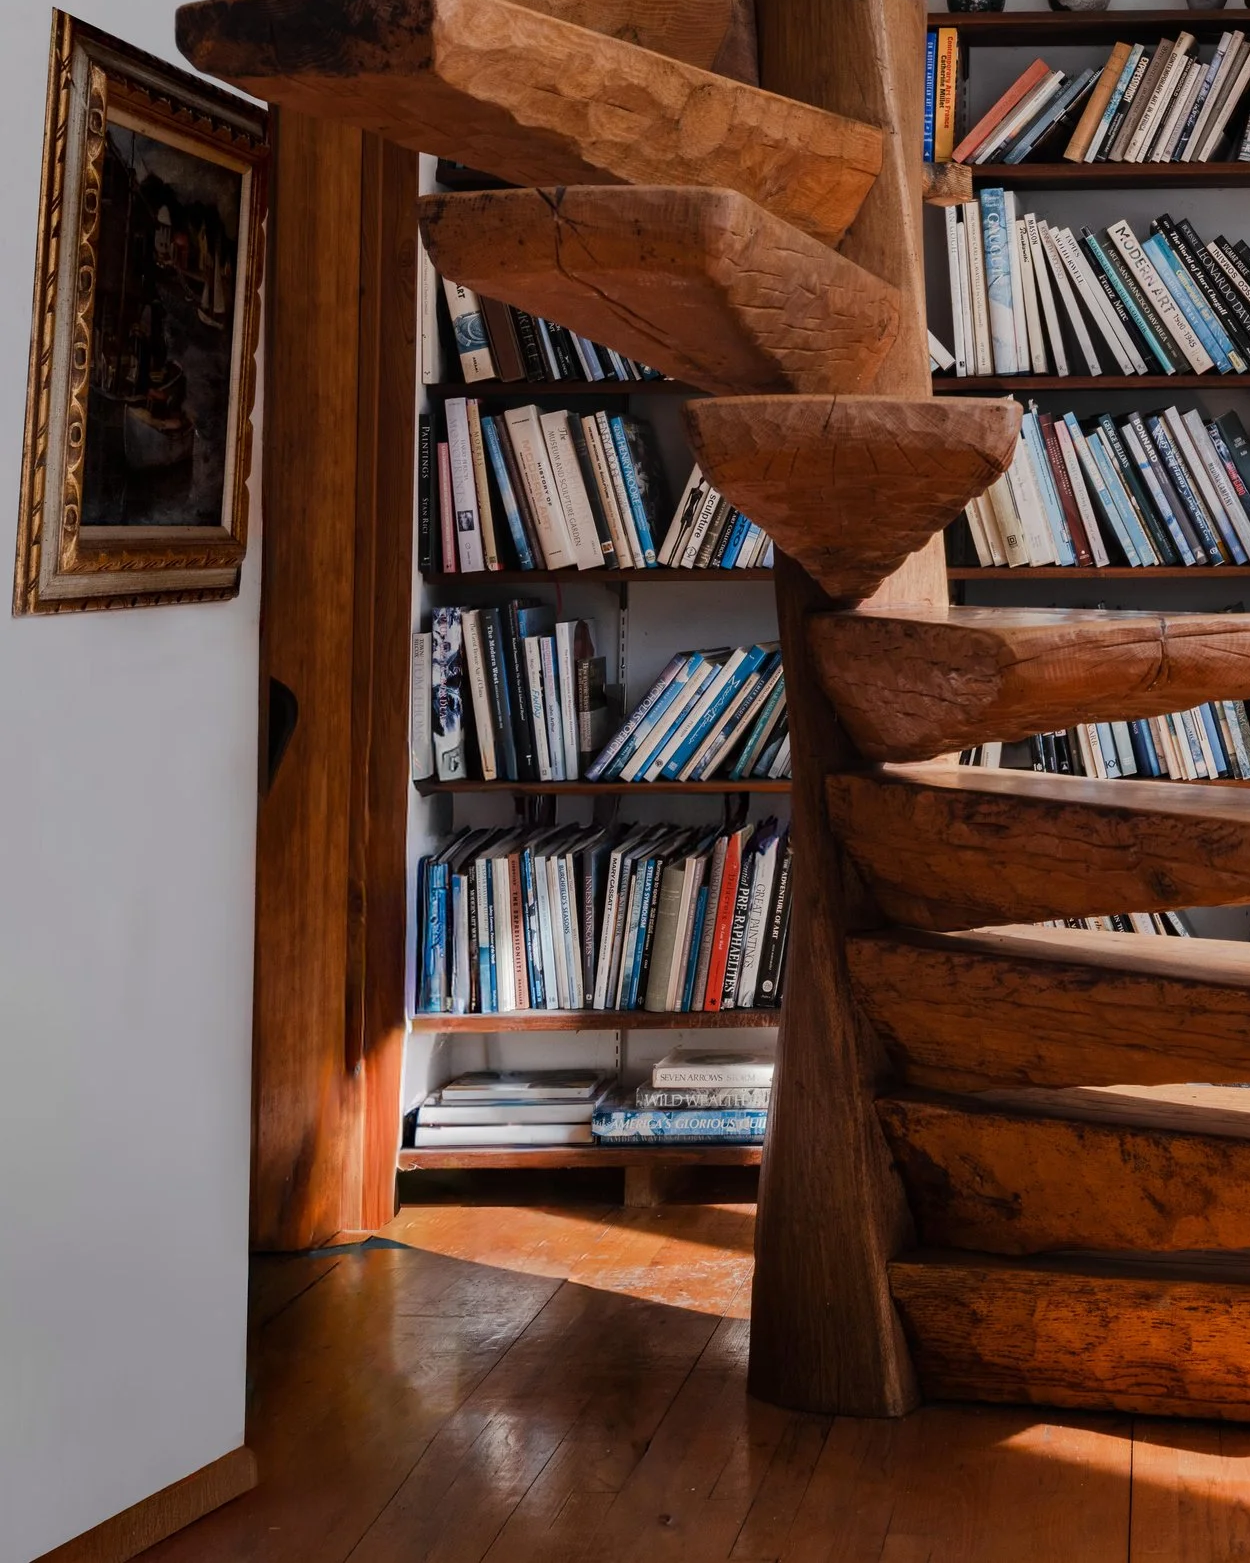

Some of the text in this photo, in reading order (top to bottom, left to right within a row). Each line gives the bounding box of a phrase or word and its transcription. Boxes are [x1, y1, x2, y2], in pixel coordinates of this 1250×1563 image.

[943, 37, 953, 83] Contemporary
[987, 213, 1003, 285] GAUGUIN
[1028, 220, 1038, 245] MASSON
[1098, 274, 1130, 322] Franz Marc
[422, 426, 430, 478] PAINTINGS
[1134, 419, 1157, 462] BONNARD
[694, 493, 718, 538] sculpture
[489, 640, 499, 665] Modern
[585, 876, 593, 954] INNESS LANDSCAPES
[606, 878, 616, 911] CASSATT
[640, 866, 653, 928] STELLA'S SYMBOLISM
[513, 910, 522, 973] EXPRESSIONISTS
[724, 888, 750, 993] PRE-RAPHAELITES
[660, 1072, 723, 1082] SEVEN ARROWS
[612, 1116, 735, 1130] AMERICA'S GLORIOUS
[644, 1094, 744, 1107] WILD WEALTH
